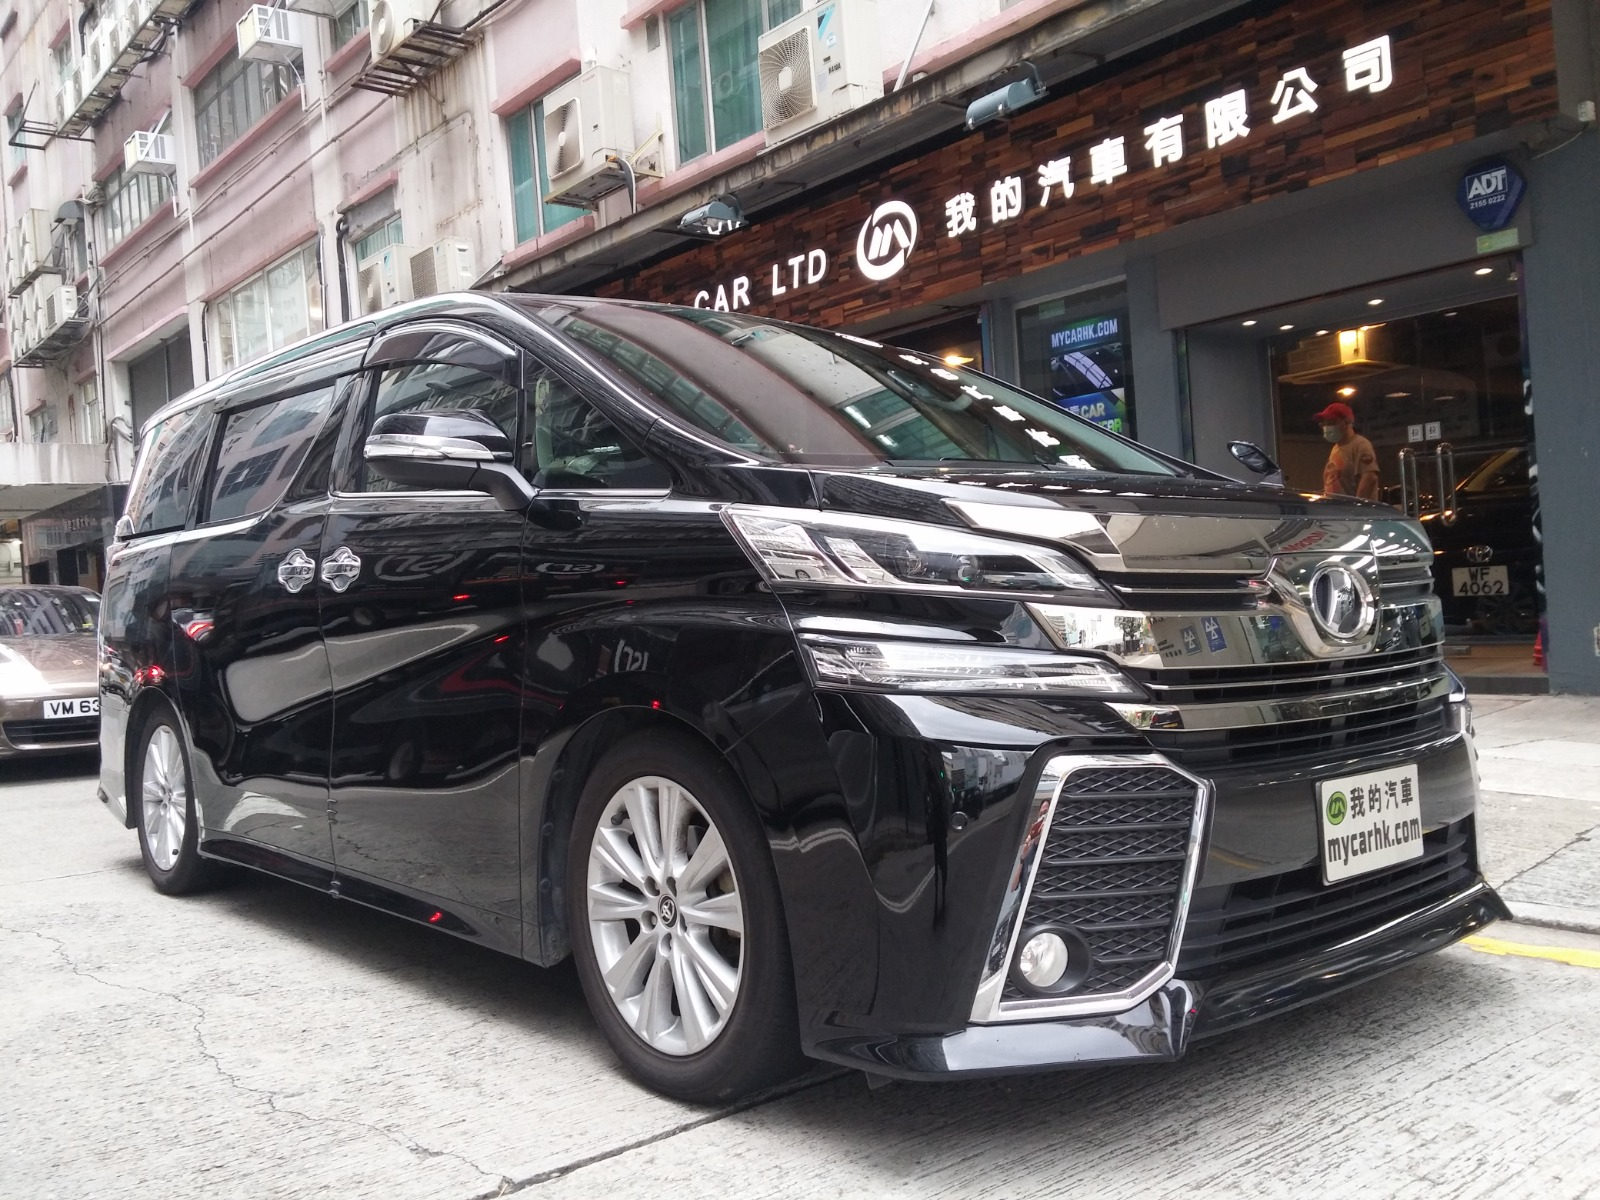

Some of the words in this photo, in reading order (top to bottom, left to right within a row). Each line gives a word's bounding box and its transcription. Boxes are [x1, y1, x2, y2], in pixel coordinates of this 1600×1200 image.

[945, 34, 1393, 238] 我的汽車有限公司
[1468, 169, 1507, 199] ADT
[1470, 200, 1487, 210] 2155
[1488, 194, 1505, 205] 0222
[694, 275, 750, 312] CAR
[772, 248, 826, 296] LTD
[1051, 319, 1118, 348] MYCARHK.COM
[1081, 402, 1106, 418] CAR
[1459, 581, 1504, 595] 4062
[1469, 567, 1490, 582] WF
[50, 701, 74, 715] VM
[1350, 777, 1413, 819] 我的汽車
[1327, 818, 1421, 866] mycarhk.com
